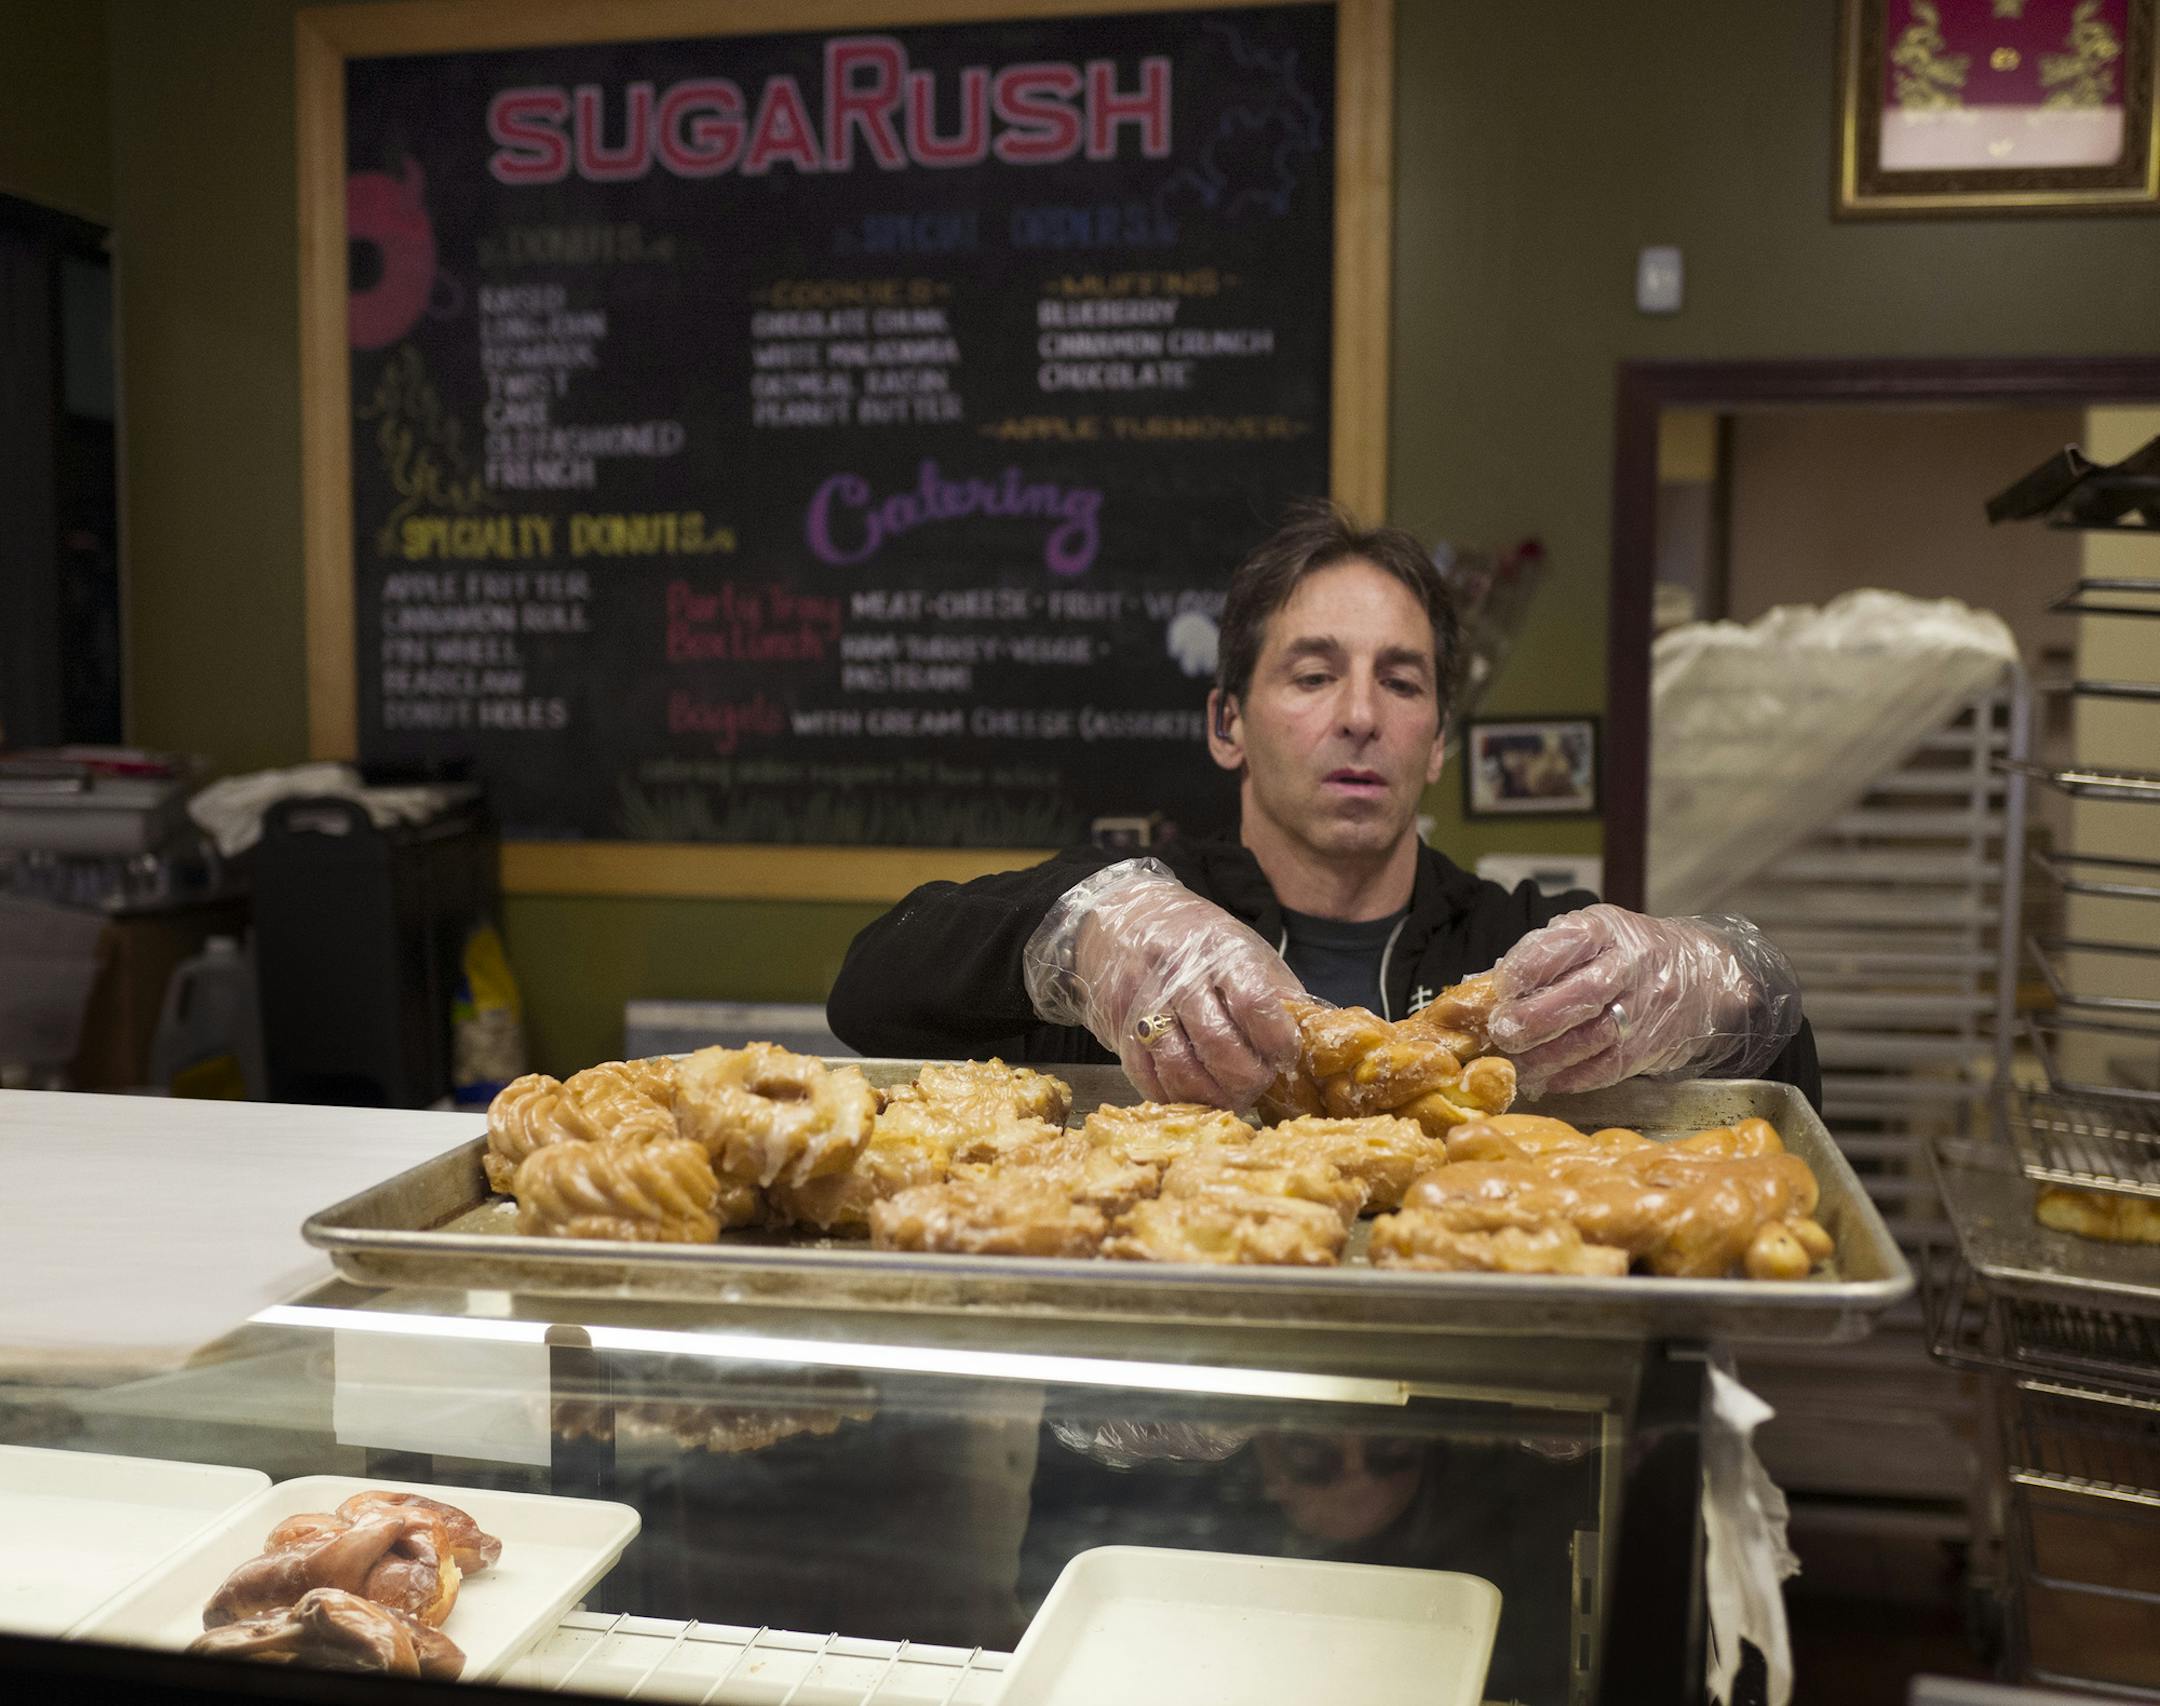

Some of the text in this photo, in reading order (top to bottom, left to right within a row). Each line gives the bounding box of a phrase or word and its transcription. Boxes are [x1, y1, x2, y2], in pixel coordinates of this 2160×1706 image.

[1036, 298, 1180, 328] BLUEBERRY
[1037, 329, 1276, 359] CINNAMON CRUNCH
[753, 393, 964, 427] PEANUT BUTTER
[486, 460, 598, 489] FRENCH
[805, 456, 1104, 576] Catering
[401, 510, 706, 559] SPECIALTY DONUTS
[849, 590, 922, 620] MEAT
[1048, 589, 1122, 621] FRUIT
[477, 697, 568, 729] HOLES
[789, 709, 863, 736] WITH
[971, 708, 1071, 738] CHEESE
